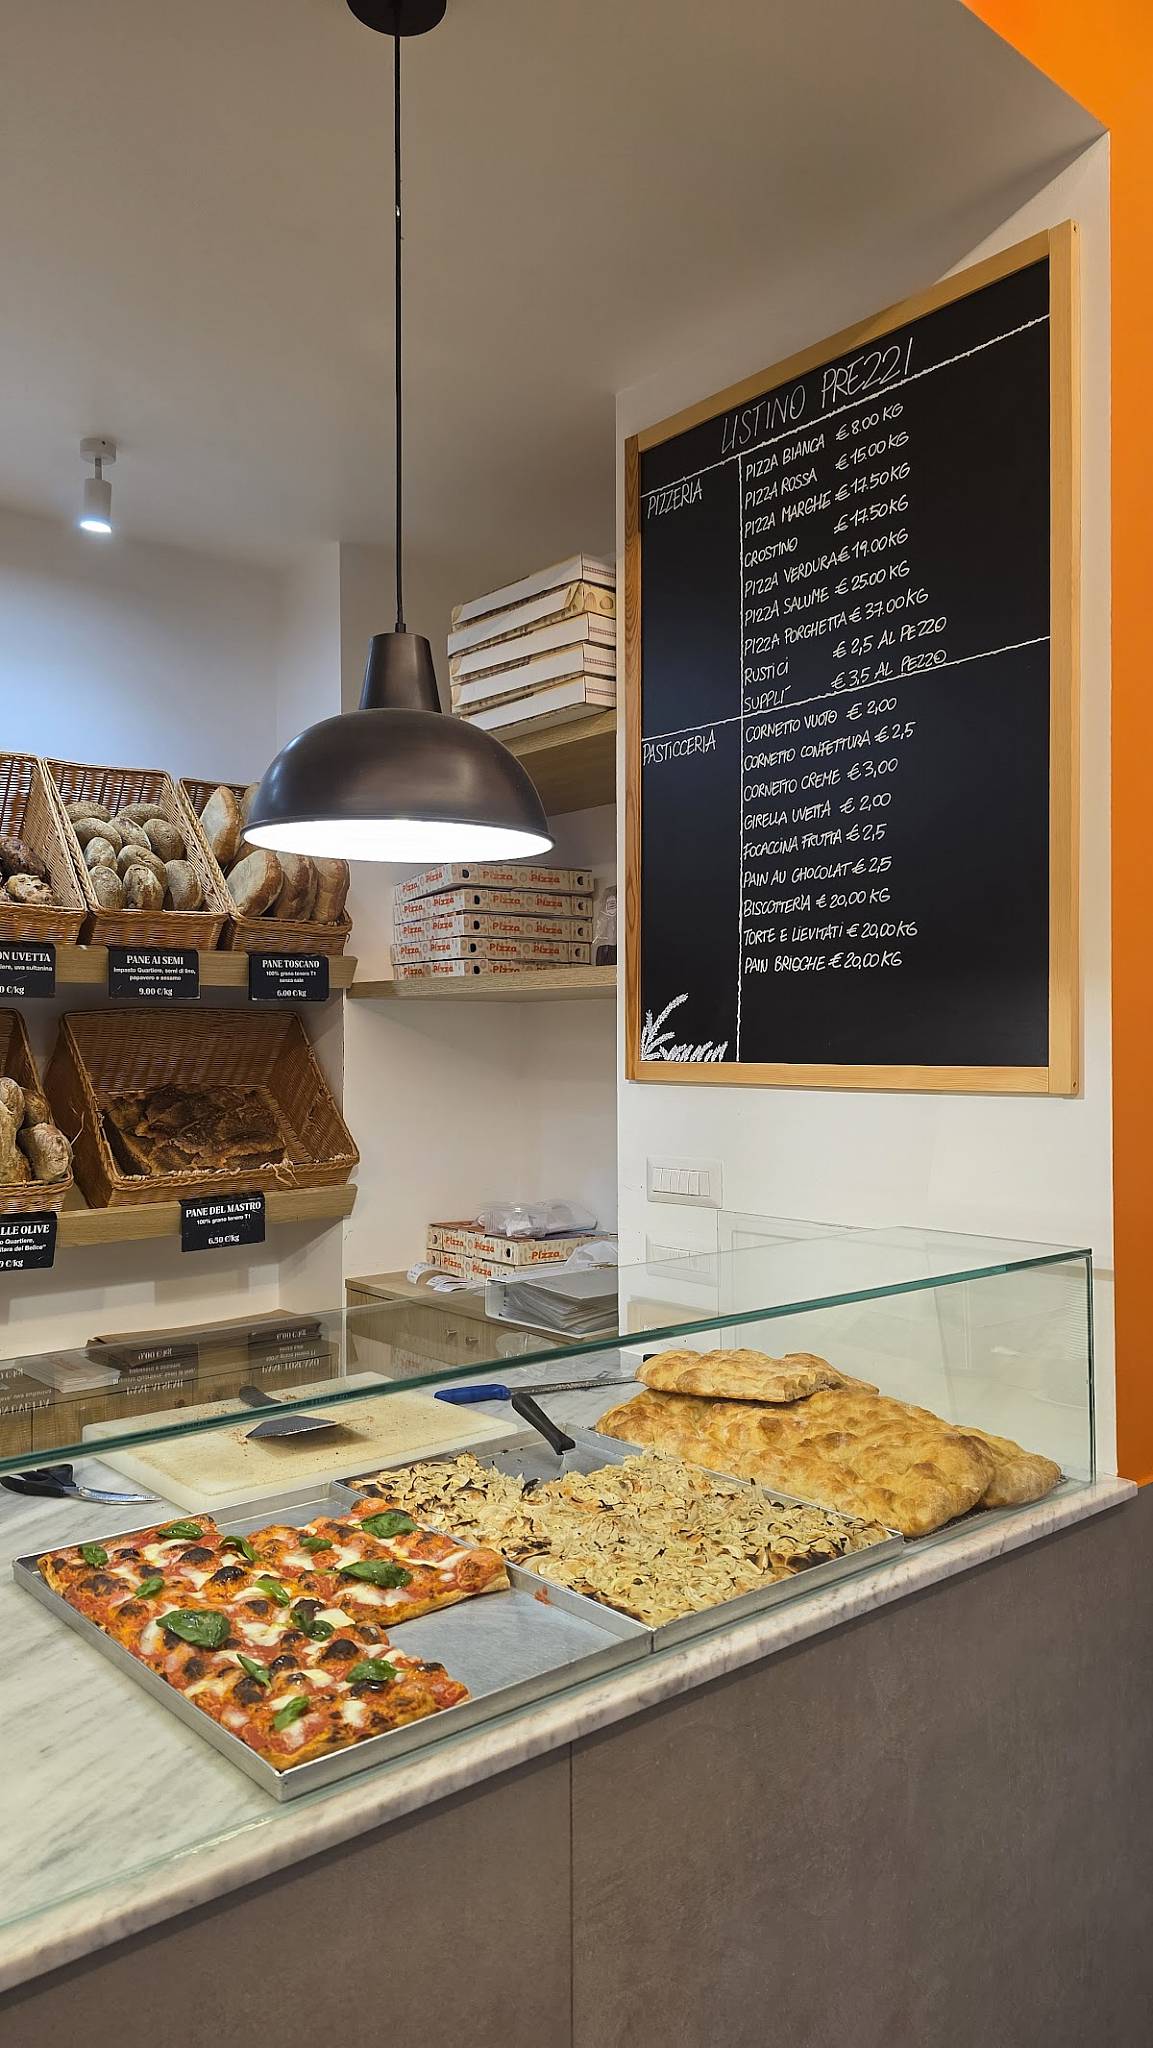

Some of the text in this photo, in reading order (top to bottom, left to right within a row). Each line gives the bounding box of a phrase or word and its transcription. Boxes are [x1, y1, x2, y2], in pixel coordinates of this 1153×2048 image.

[721, 385, 806, 454] LISTINO
[745, 454, 779, 482] PIZZA
[782, 434, 826, 466] BIANCA
[882, 403, 904, 421] KG
[744, 484, 778, 510] PIZZA
[780, 467, 818, 496] ROSSA
[647, 479, 703, 519] PIZZERIA
[744, 511, 776, 539] PIZZA
[780, 490, 832, 523] MARGHE
[744, 537, 799, 568] CROSTINO
[744, 571, 779, 598] PIZZA
[784, 552, 838, 584] VERDURA
[744, 599, 780, 627] PIZZA
[783, 586, 830, 615] SALUME
[889, 560, 911, 580] KG
[877, 629, 896, 649] AL
[899, 616, 948, 642] PEZZO
[744, 633, 780, 656] PIZZA
[873, 662, 894, 680] AL
[900, 649, 947, 676] PEZZO
[745, 719, 801, 743] CORNETTO
[804, 710, 838, 729] VUOTO
[642, 728, 716, 767] PASTICCERIA
[744, 748, 796, 771] CORNETTO
[800, 730, 871, 758] CONFETTURA
[744, 779, 798, 802] CORNETTO
[800, 769, 842, 790] CREME
[744, 811, 788, 830] GIRELLA
[791, 800, 832, 823] UVETTA
[801, 828, 843, 849] FRUTTA
[425, 871, 443, 883] Pizza
[482, 870, 513, 882] Pizza
[531, 873, 560, 884] Pizza
[743, 871, 769, 888] PAIN
[770, 870, 787, 886] AU
[402, 881, 418, 893] Pizza
[433, 895, 454, 907] Pizza
[492, 895, 521, 905] Pizza
[536, 897, 563, 908] Pizza
[743, 894, 811, 917] BISCOTTERIA
[868, 888, 891, 904] KG
[403, 902, 422, 913] Pizza
[403, 926, 422, 935] Pizza
[432, 919, 453, 930] Pizza
[492, 922, 521, 932] Pizza
[536, 923, 563, 934] Pizza
[743, 927, 776, 946] TORTE
[780, 929, 788, 942] E
[400, 947, 420, 955] Pizza
[430, 942, 451, 952] Pizza
[489, 943, 517, 953] Pizza
[533, 944, 560, 955] Pizza
[12, 952, 51, 962] UVETTA
[126, 955, 184, 965] PANE AI SEMI
[262, 960, 320, 968] PANE TOSCANO
[432, 963, 453, 974] Pizza
[744, 957, 768, 974] PAIN
[774, 955, 826, 972] BRIOCHE
[403, 967, 423, 976] Pizza
[138, 988, 156, 996] 9.00
[185, 1201, 262, 1218] PANE DEL MASTRO
[20, 1224, 50, 1235] OLIVE
[445, 1236, 464, 1248] Pizza
[473, 1241, 495, 1254] Pizza
[531, 1249, 560, 1260] Pizza
[443, 1256, 462, 1269] Pizza
[472, 1264, 492, 1277] Pizza
